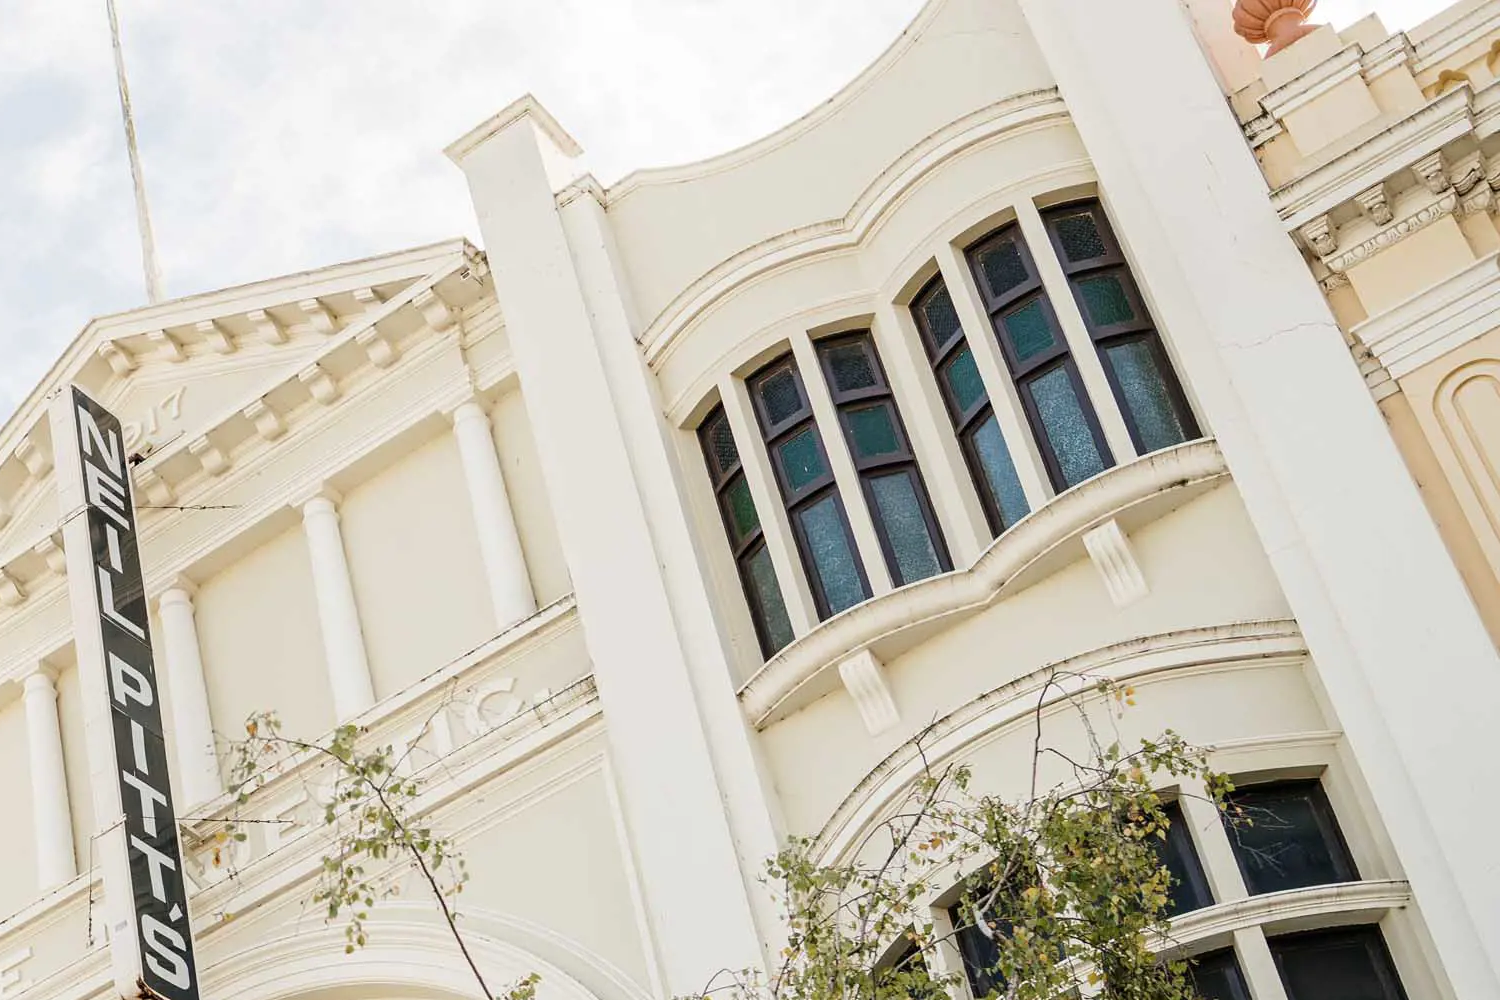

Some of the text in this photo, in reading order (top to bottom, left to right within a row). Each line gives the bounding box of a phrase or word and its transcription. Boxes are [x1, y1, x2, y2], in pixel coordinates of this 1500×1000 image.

[125, 384, 188, 451] 917
[77, 405, 190, 990] NEIL PITT'S
